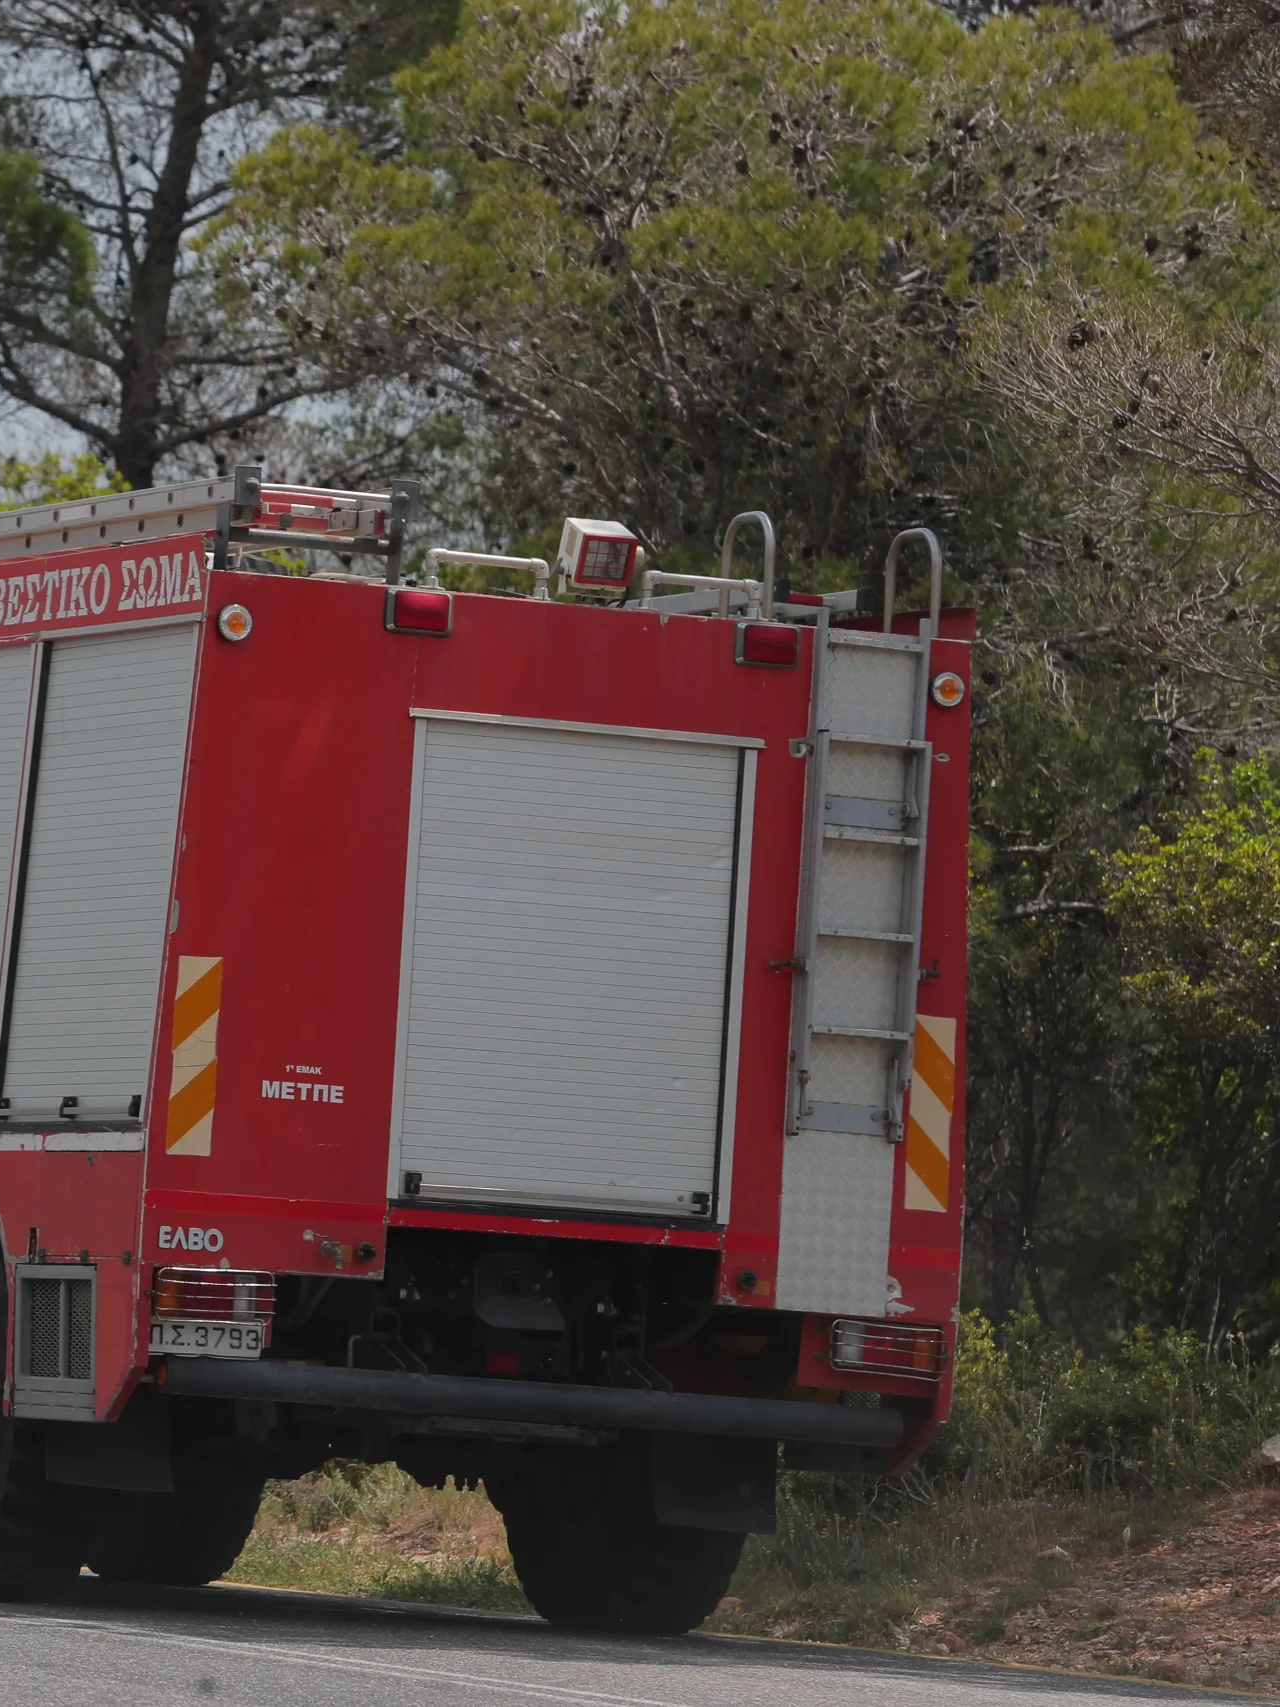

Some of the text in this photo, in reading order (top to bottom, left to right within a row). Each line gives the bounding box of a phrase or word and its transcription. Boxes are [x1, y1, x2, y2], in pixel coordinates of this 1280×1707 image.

[118, 550, 203, 611] ΣΩΜΑ
[261, 1080, 344, 1103] ΜΕΤΠΕ
[158, 1225, 224, 1252] ΕΛΒΟ
